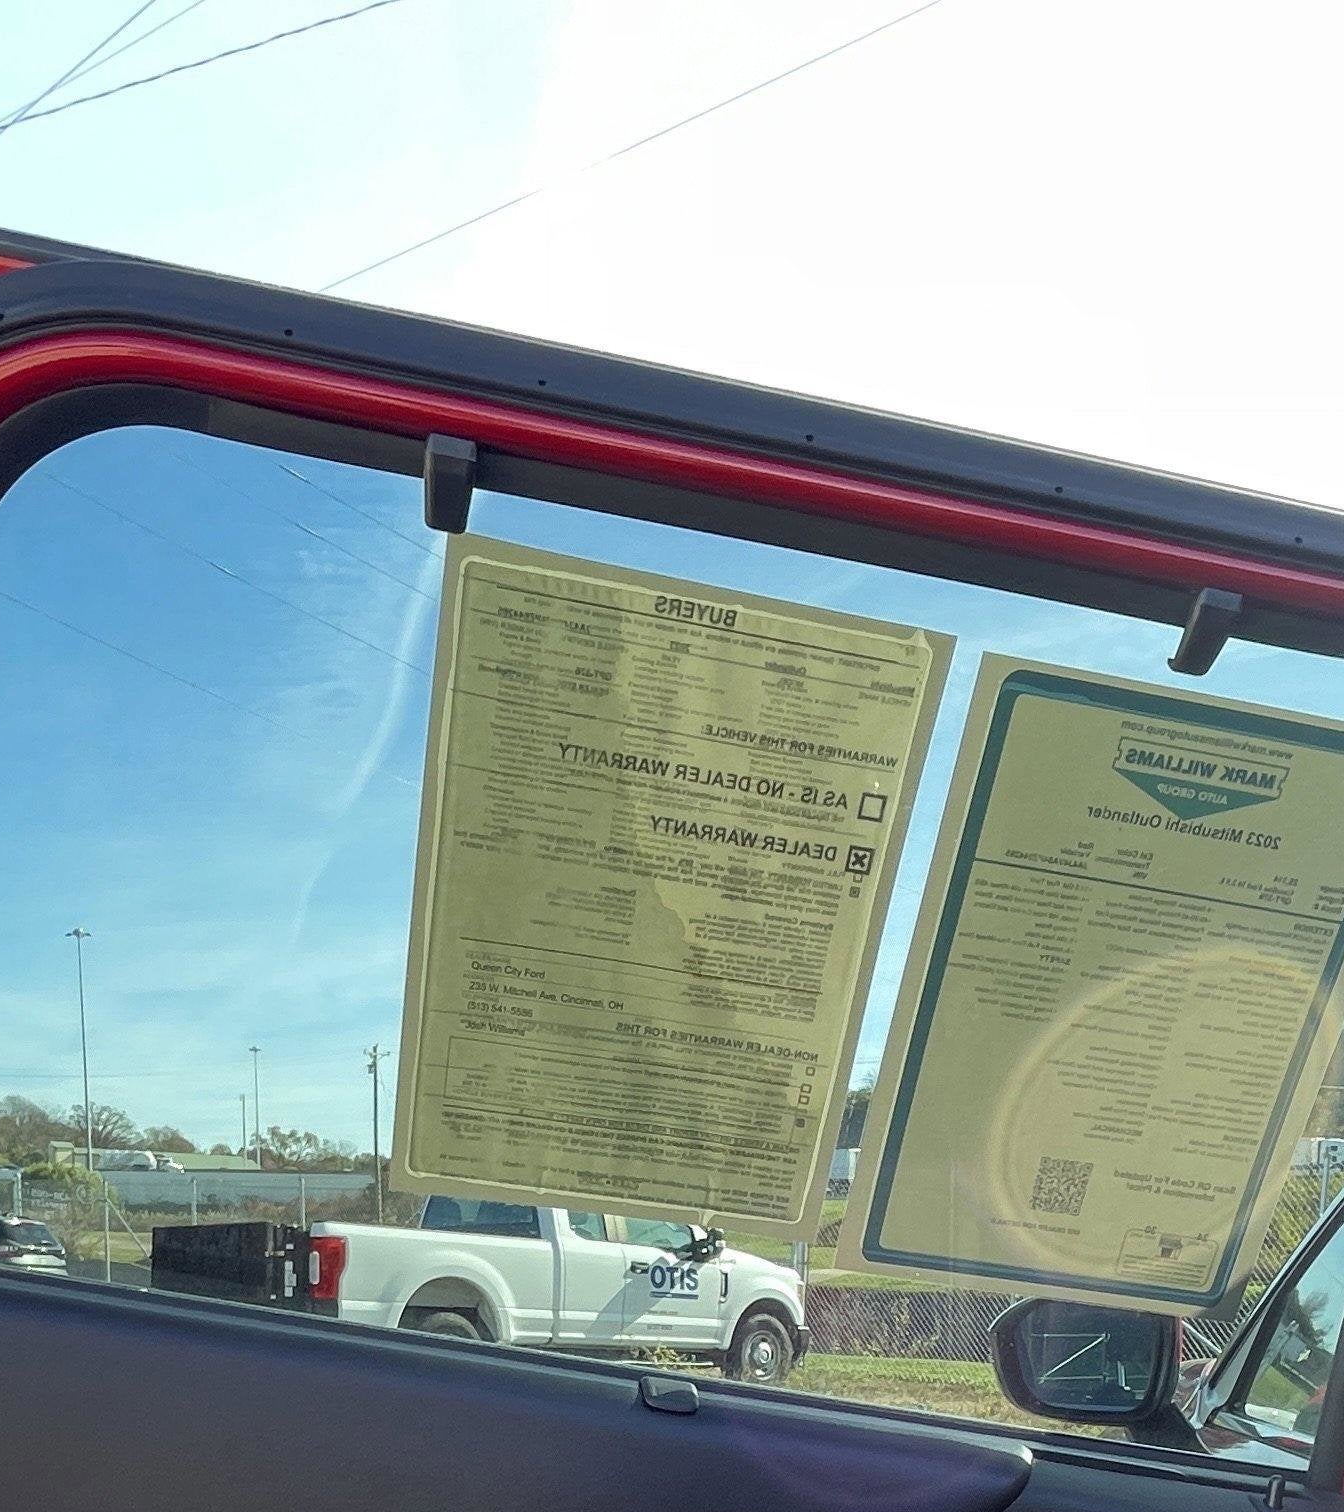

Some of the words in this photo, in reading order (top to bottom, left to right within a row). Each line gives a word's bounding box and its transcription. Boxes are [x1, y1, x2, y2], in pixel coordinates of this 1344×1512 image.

[503, 965, 522, 977] City
[523, 967, 545, 979] Ford
[607, 1000, 624, 1010] OH
[651, 1265, 699, 1291] OTIS
